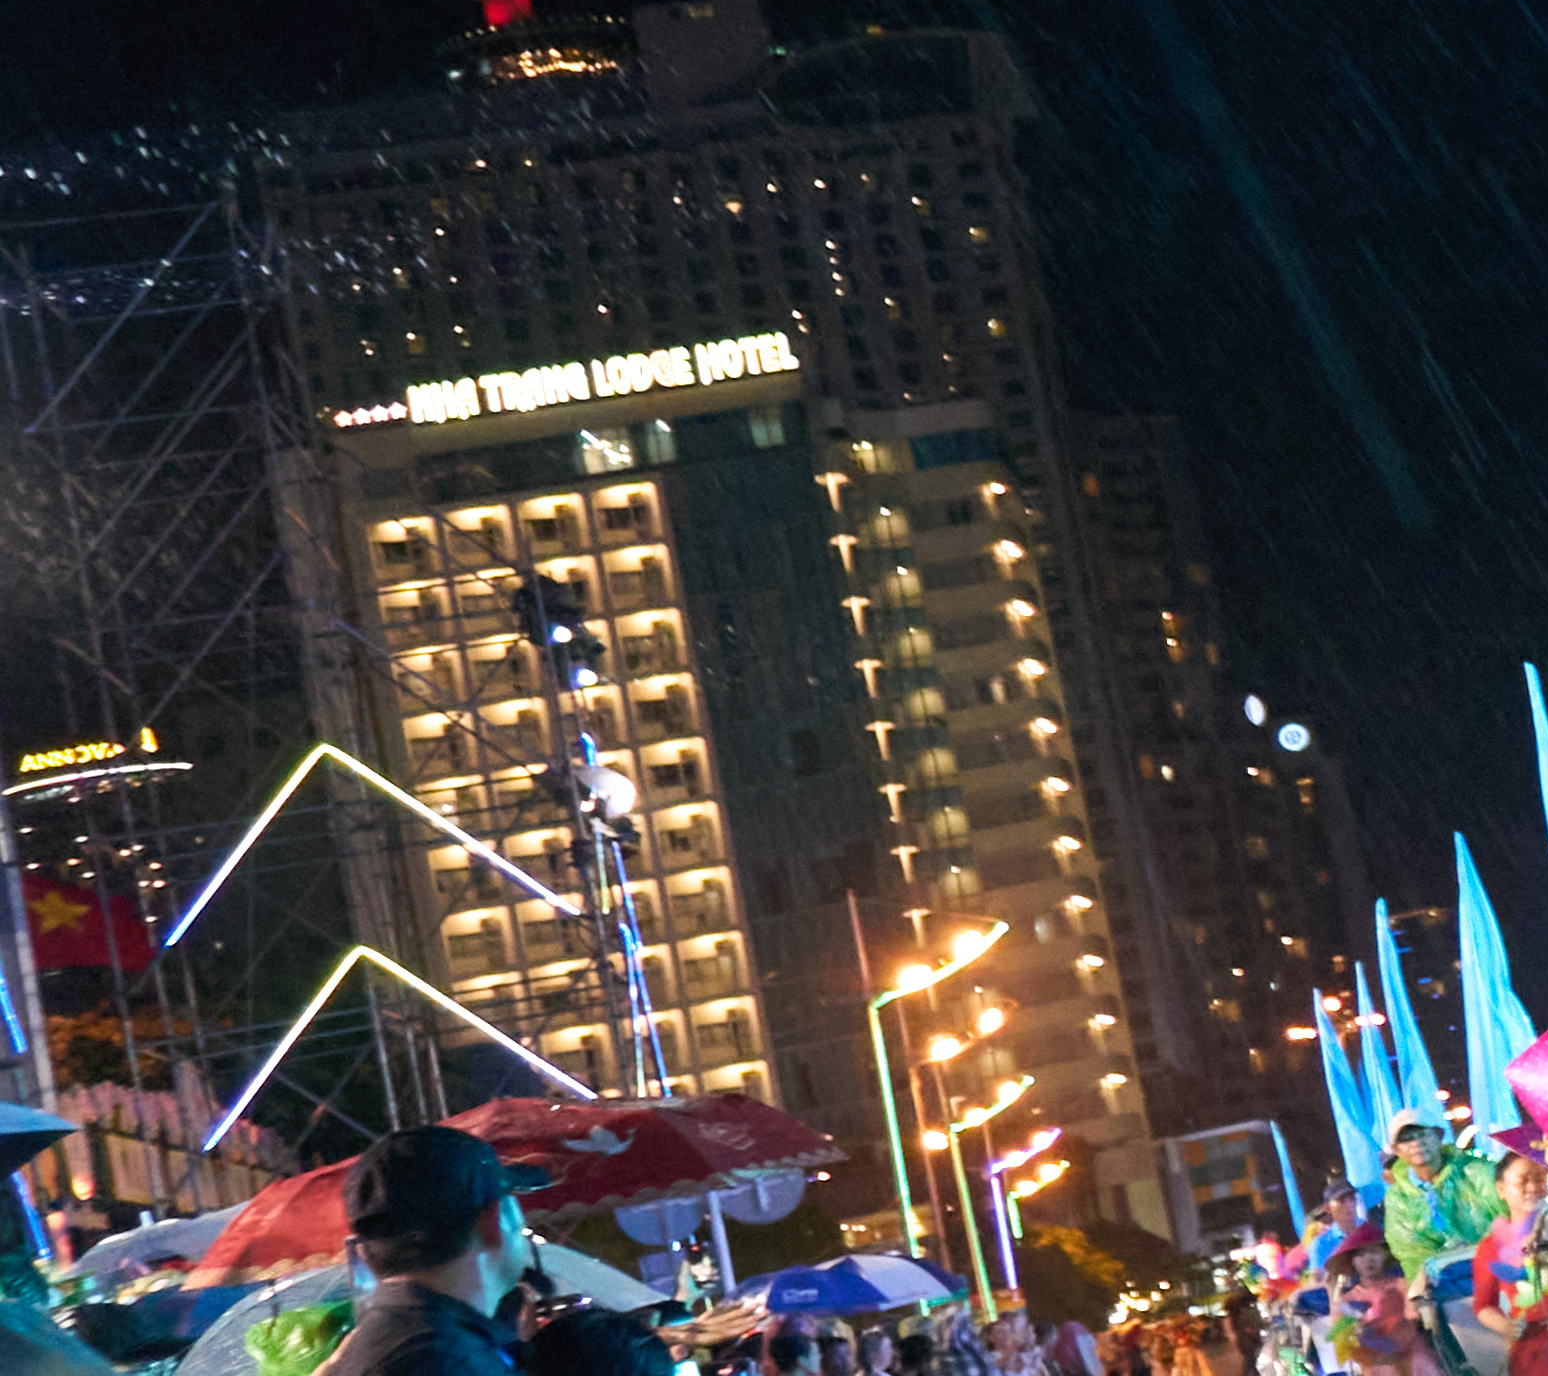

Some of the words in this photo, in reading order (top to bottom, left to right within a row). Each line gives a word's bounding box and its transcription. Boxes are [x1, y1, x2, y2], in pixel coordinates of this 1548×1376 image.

[407, 377, 481, 423] NHA
[480, 362, 591, 413] TRANG
[592, 345, 695, 398] LODGE
[697, 331, 800, 386] HOTEL
